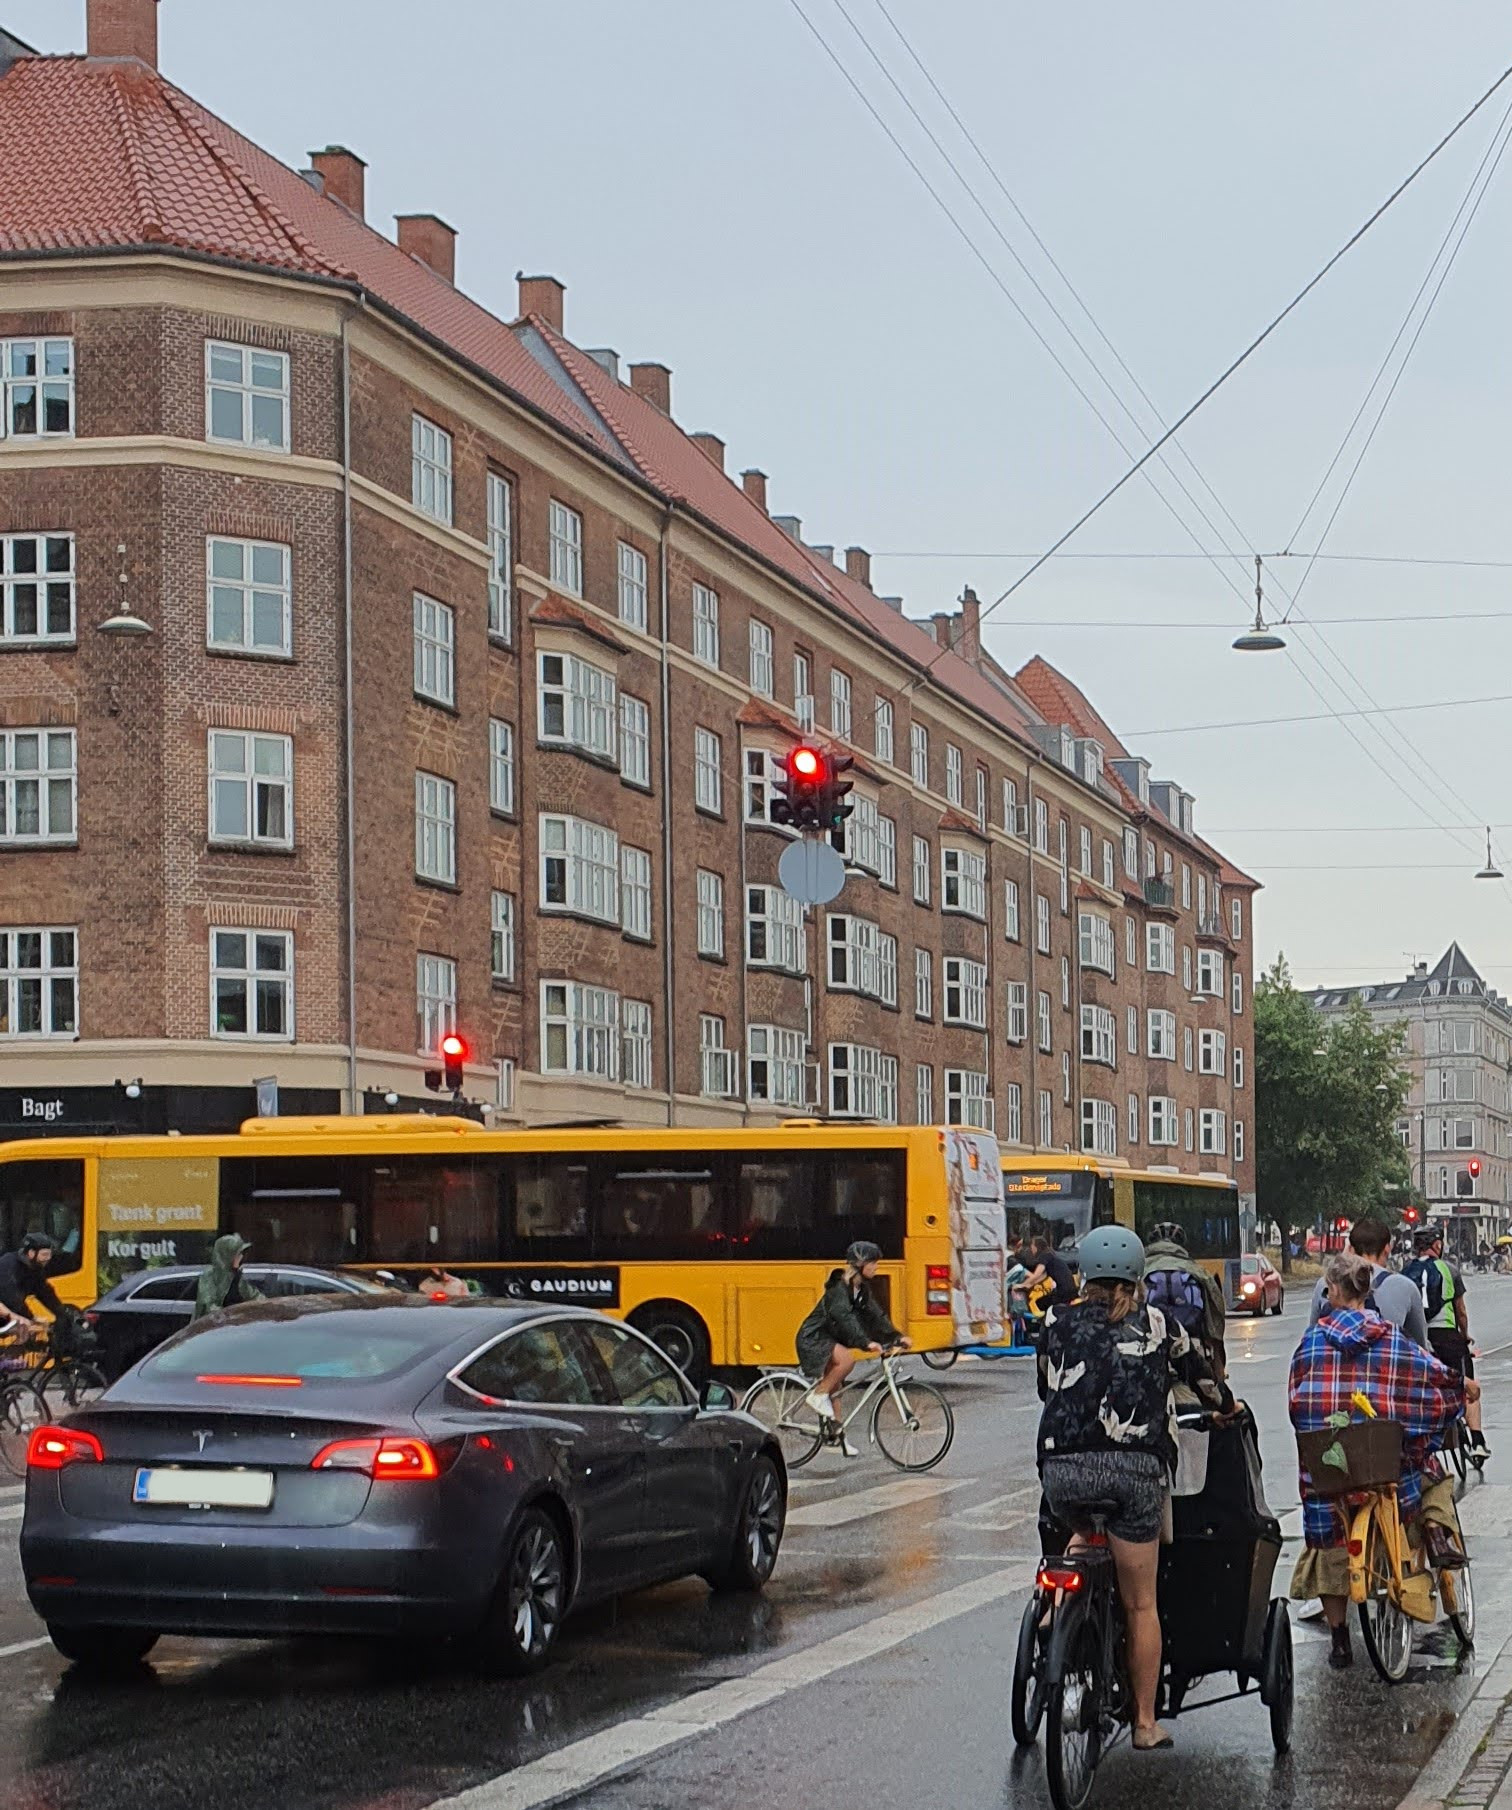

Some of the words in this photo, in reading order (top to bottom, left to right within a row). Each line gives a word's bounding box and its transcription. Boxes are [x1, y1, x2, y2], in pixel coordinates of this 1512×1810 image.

[22, 1098, 64, 1120] Bagt
[140, 1239, 177, 1260] gult
[530, 1279, 613, 1292] GAUDIUM
